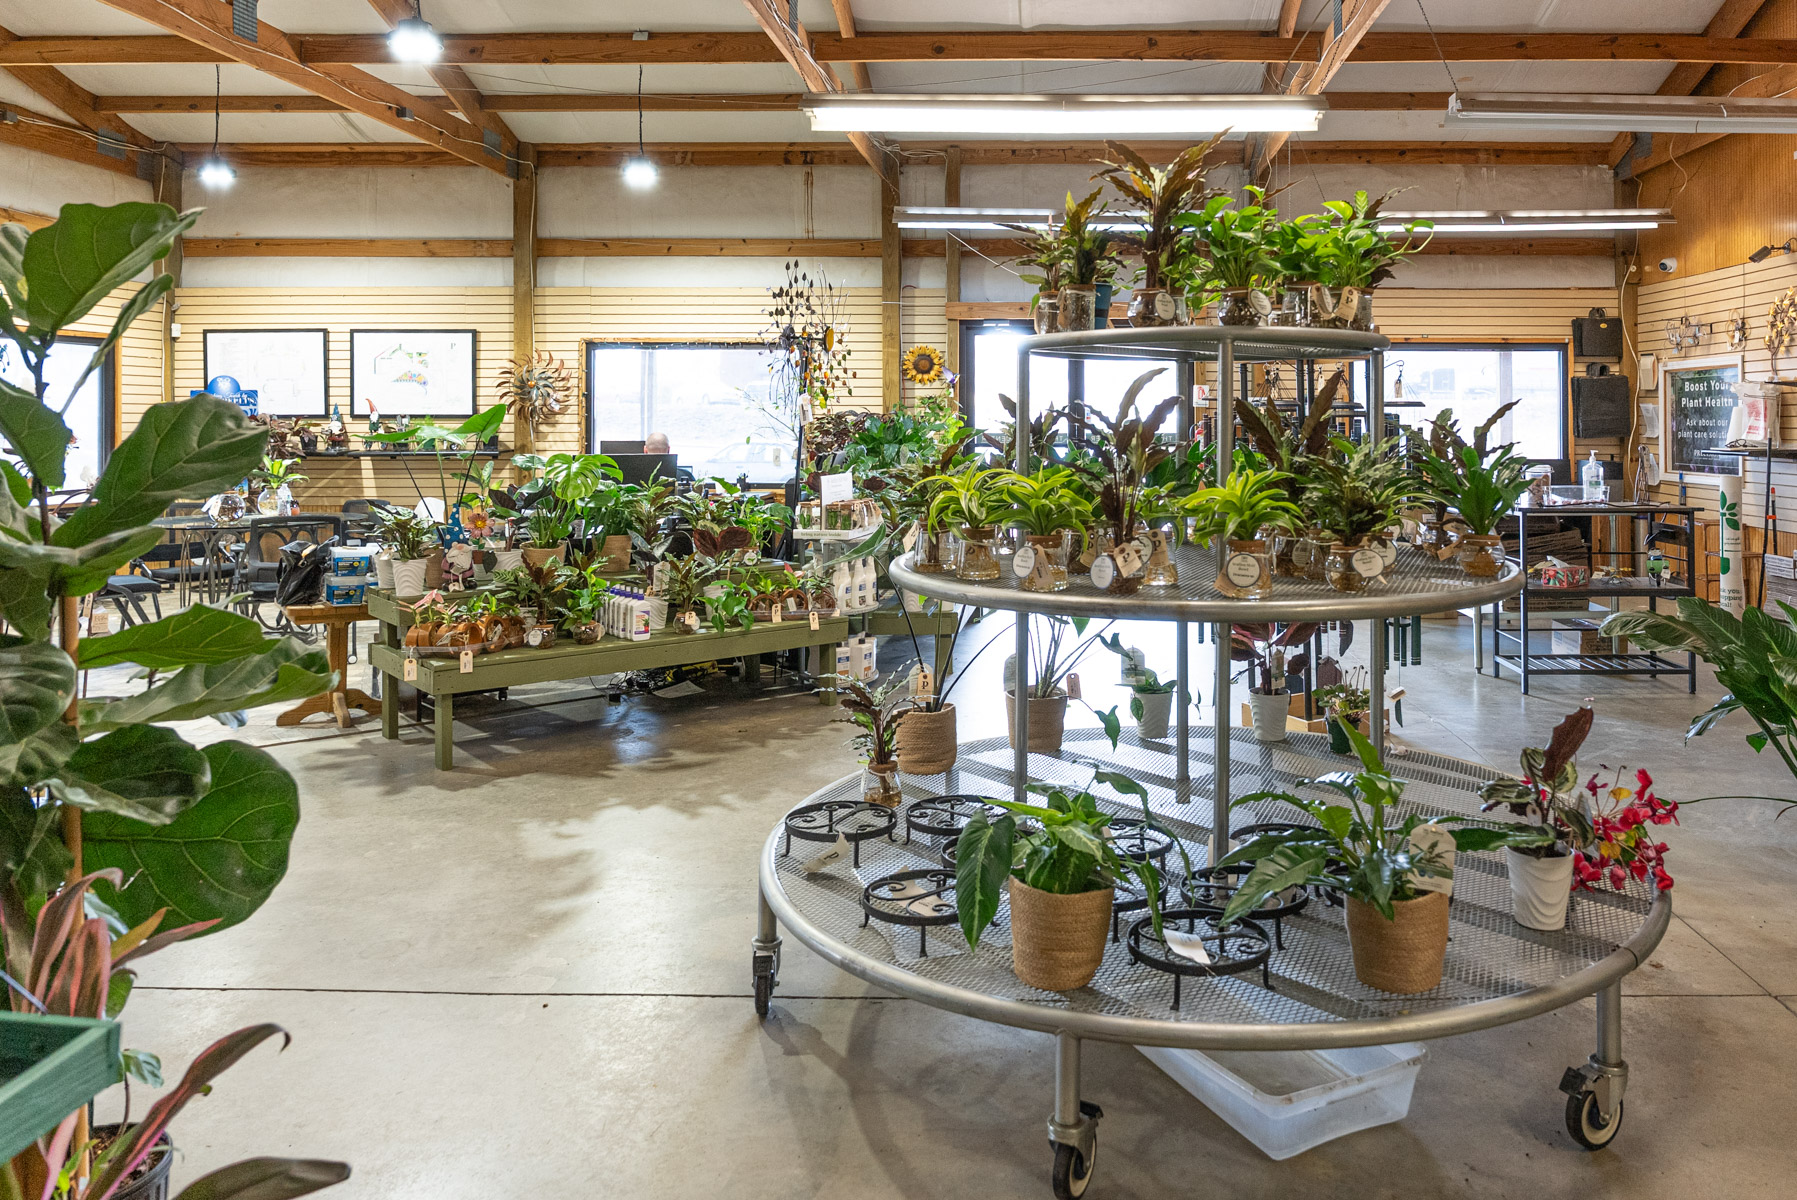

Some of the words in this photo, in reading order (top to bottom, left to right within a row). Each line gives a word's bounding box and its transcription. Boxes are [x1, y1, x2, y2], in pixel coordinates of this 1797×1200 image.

[1684, 381, 1708, 392] Boost
[1681, 397, 1703, 407] Plant
[1686, 418, 1697, 426] Ask
[1699, 417, 1716, 426] about
[1677, 430, 1693, 439] plant
